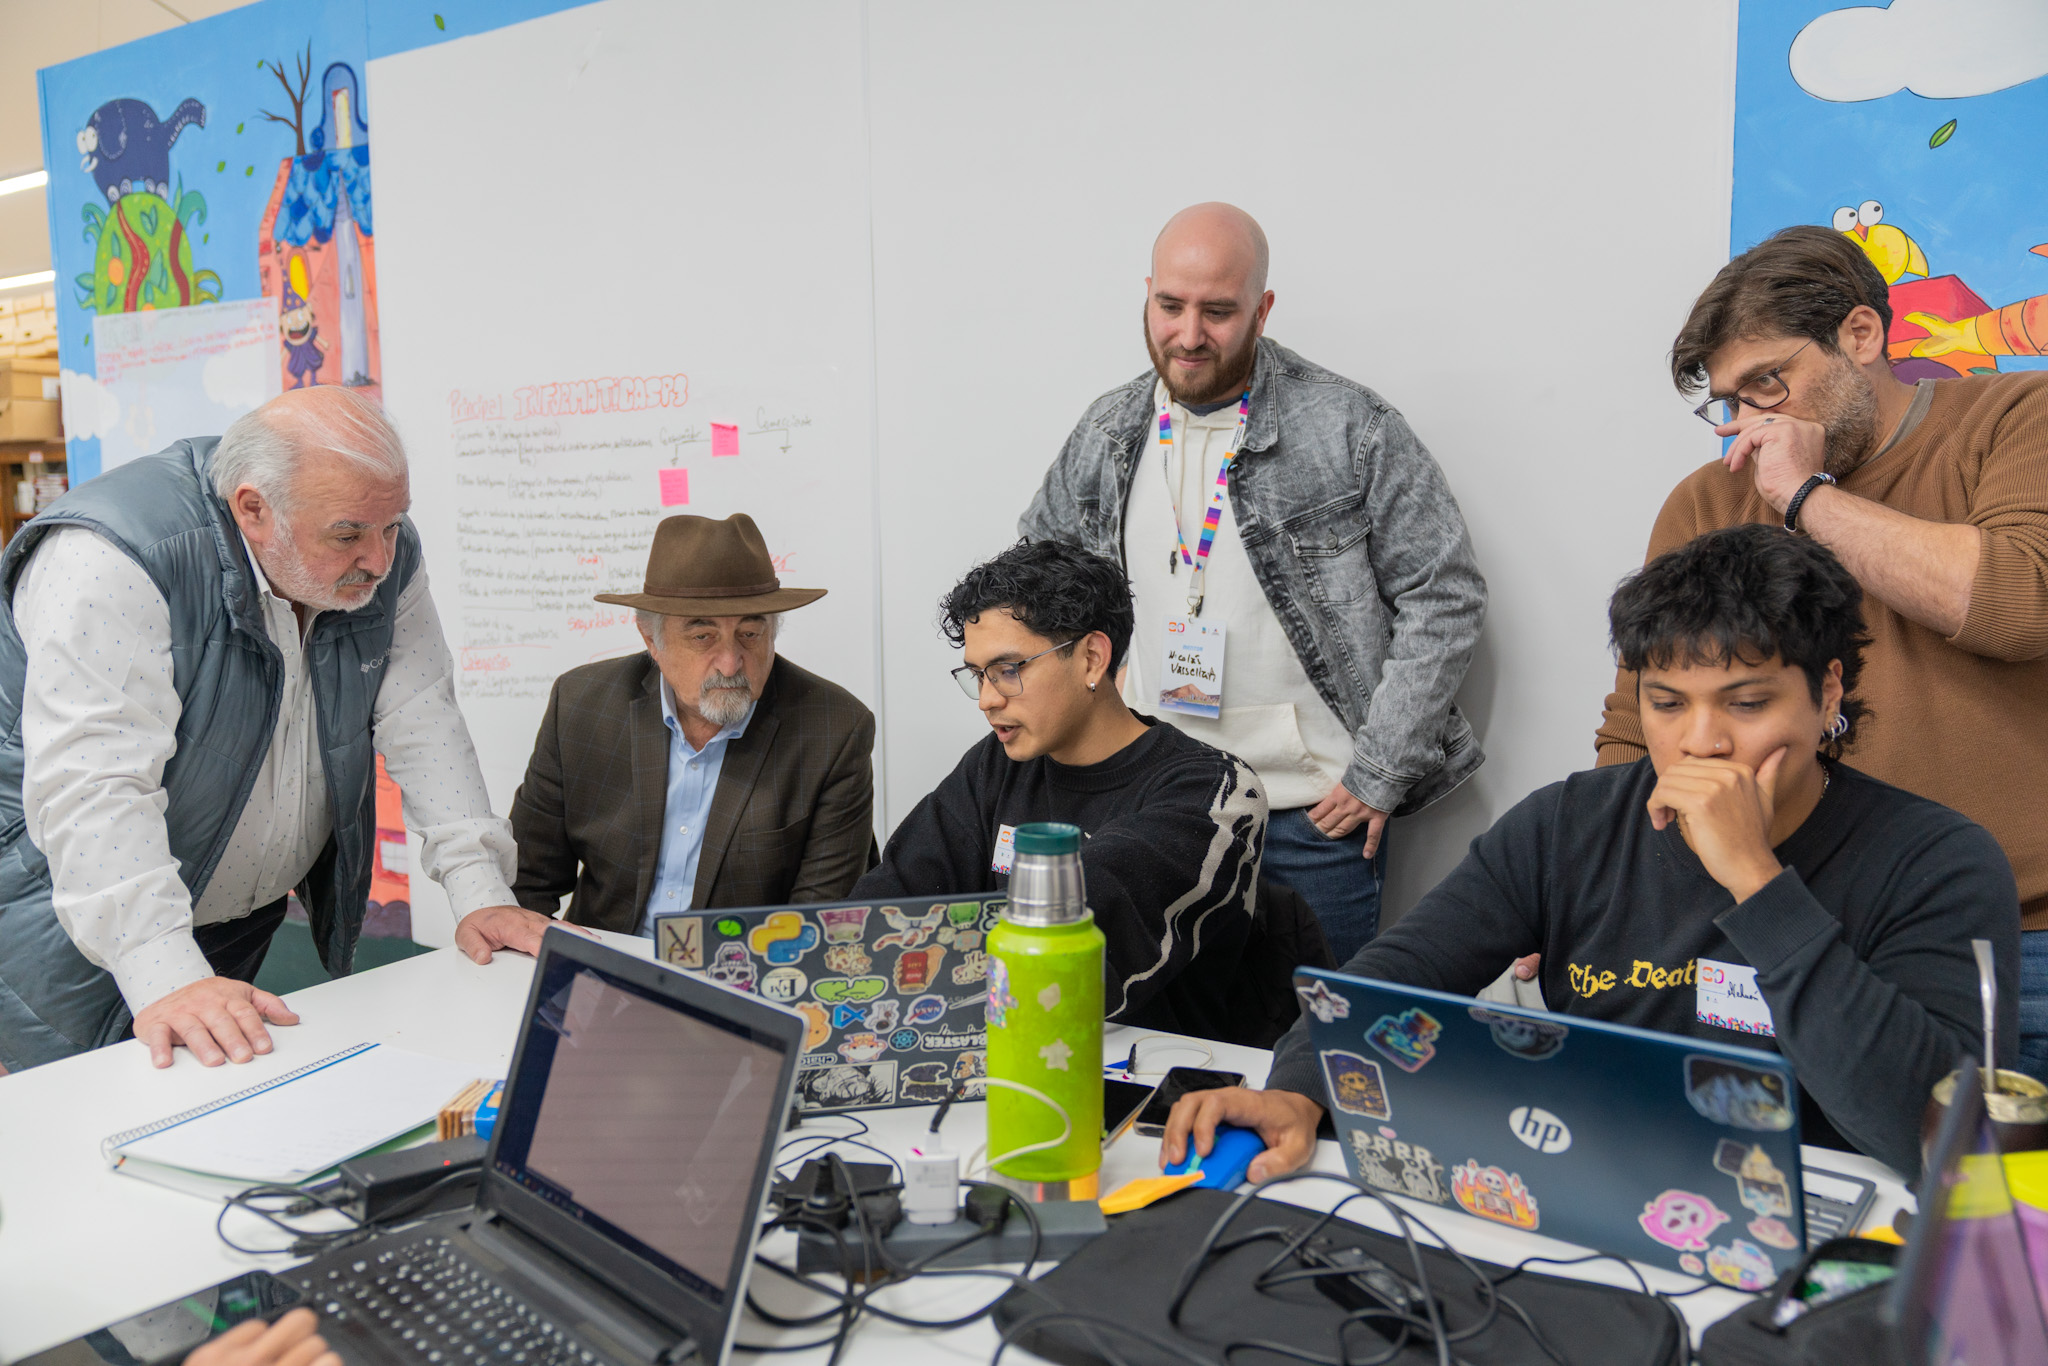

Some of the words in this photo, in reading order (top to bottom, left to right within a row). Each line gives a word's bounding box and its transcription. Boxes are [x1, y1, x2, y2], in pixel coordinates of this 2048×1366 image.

[1568, 963, 1617, 998] The
[1624, 957, 1698, 989] Deat
[915, 1005, 941, 1014] NASA
[925, 1032, 986, 1049] BLASTER
[1520, 1106, 1563, 1151] hp
